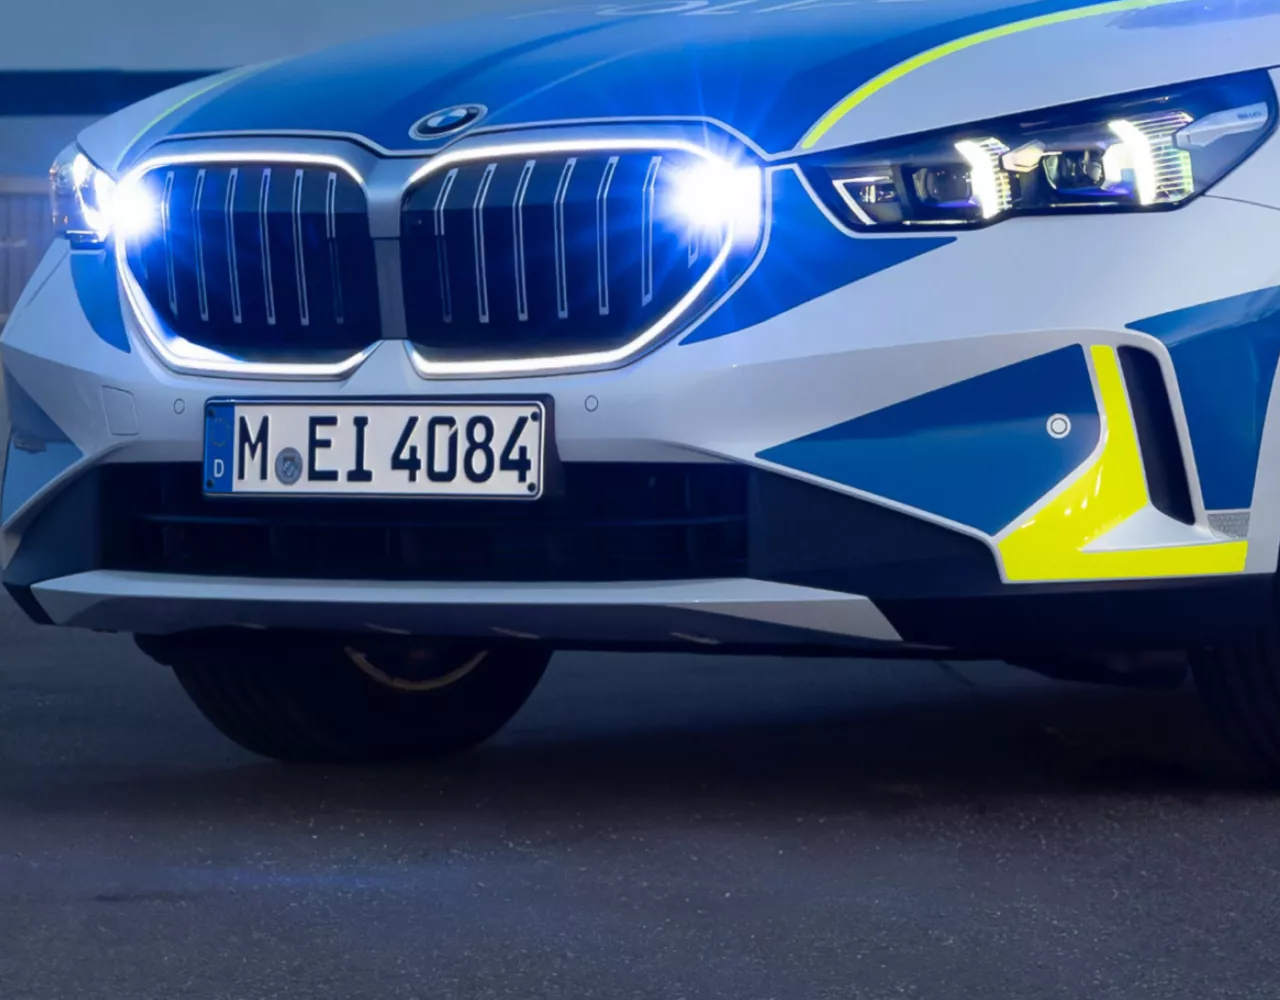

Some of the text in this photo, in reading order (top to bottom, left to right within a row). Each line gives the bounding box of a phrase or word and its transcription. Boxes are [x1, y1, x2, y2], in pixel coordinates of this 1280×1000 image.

[213, 459, 225, 478] D
[238, 415, 532, 483] M EI 4084
